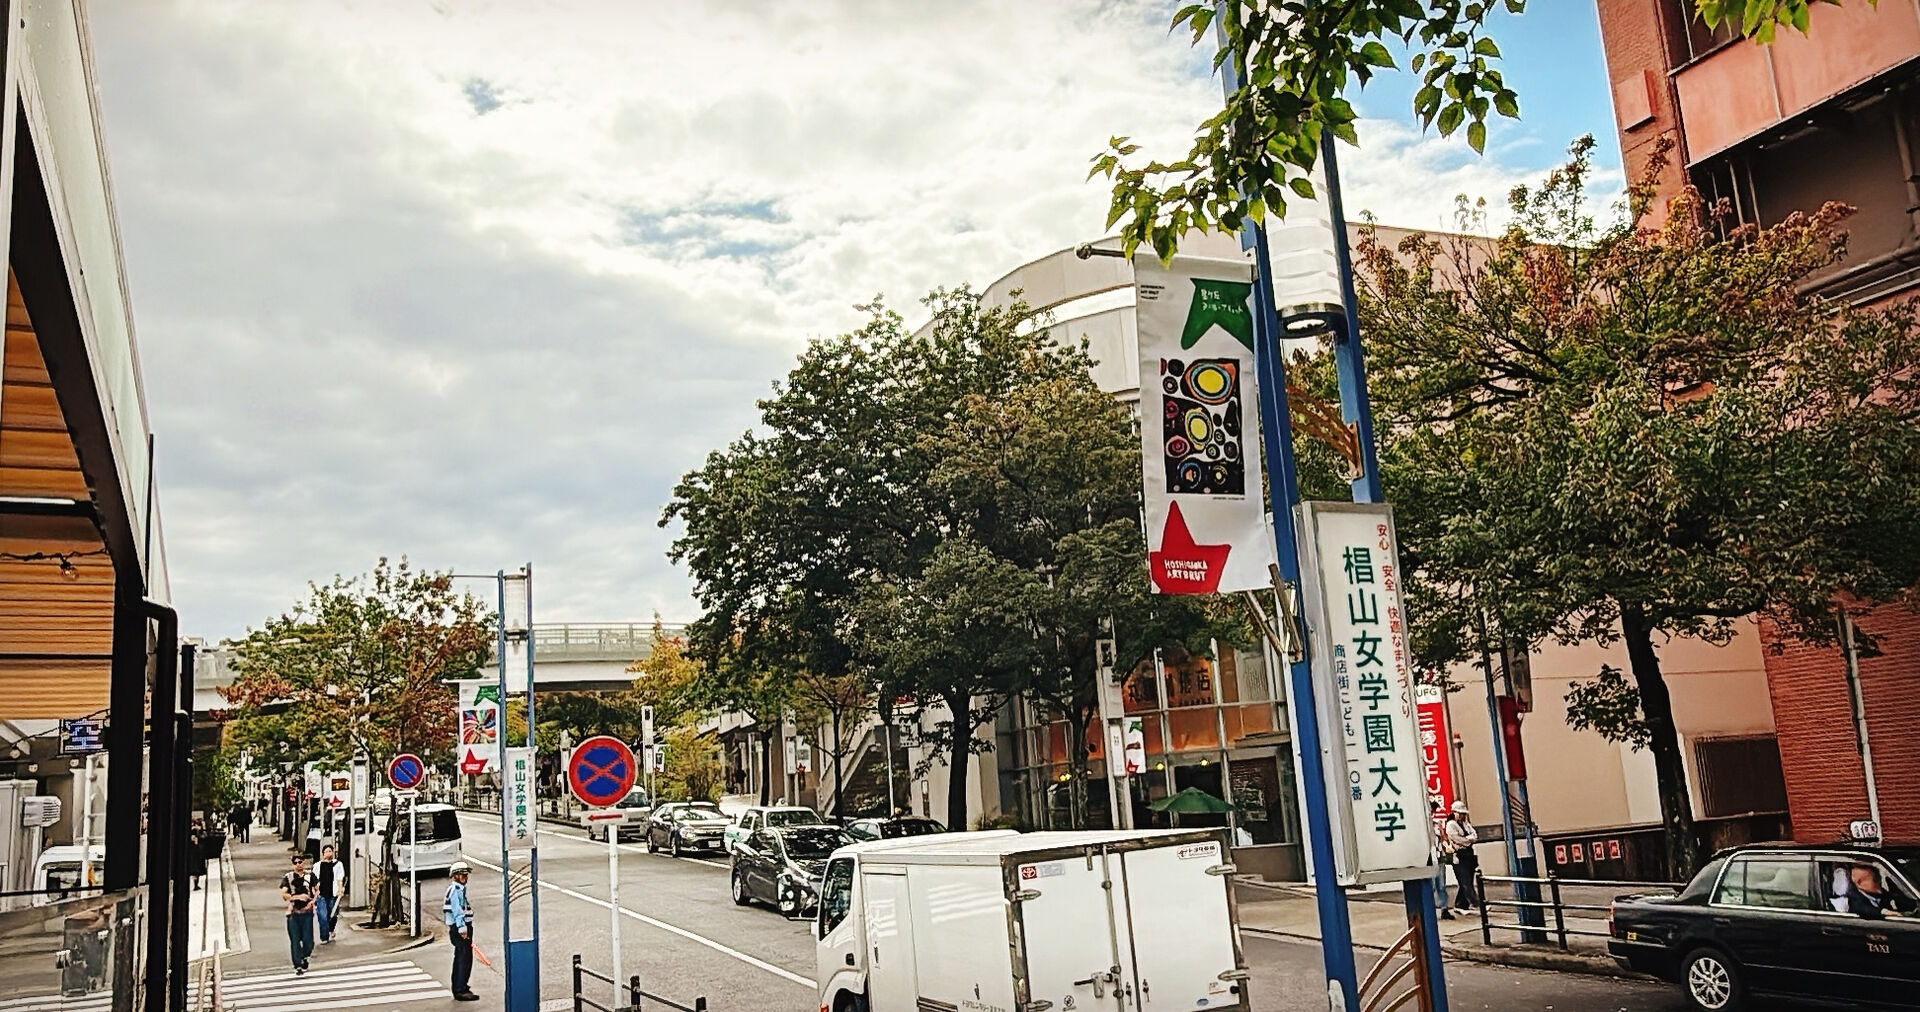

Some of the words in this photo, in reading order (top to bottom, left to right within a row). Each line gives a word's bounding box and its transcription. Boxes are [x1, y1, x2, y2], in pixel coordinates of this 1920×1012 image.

[1164, 560, 1208, 570] HOSHIGAOKA
[1167, 569, 1182, 579] ART
[1182, 570, 1206, 581] BRUT
[1343, 546, 1406, 841] 椙山女学園大学
[1866, 942, 1890, 954] TAXI
